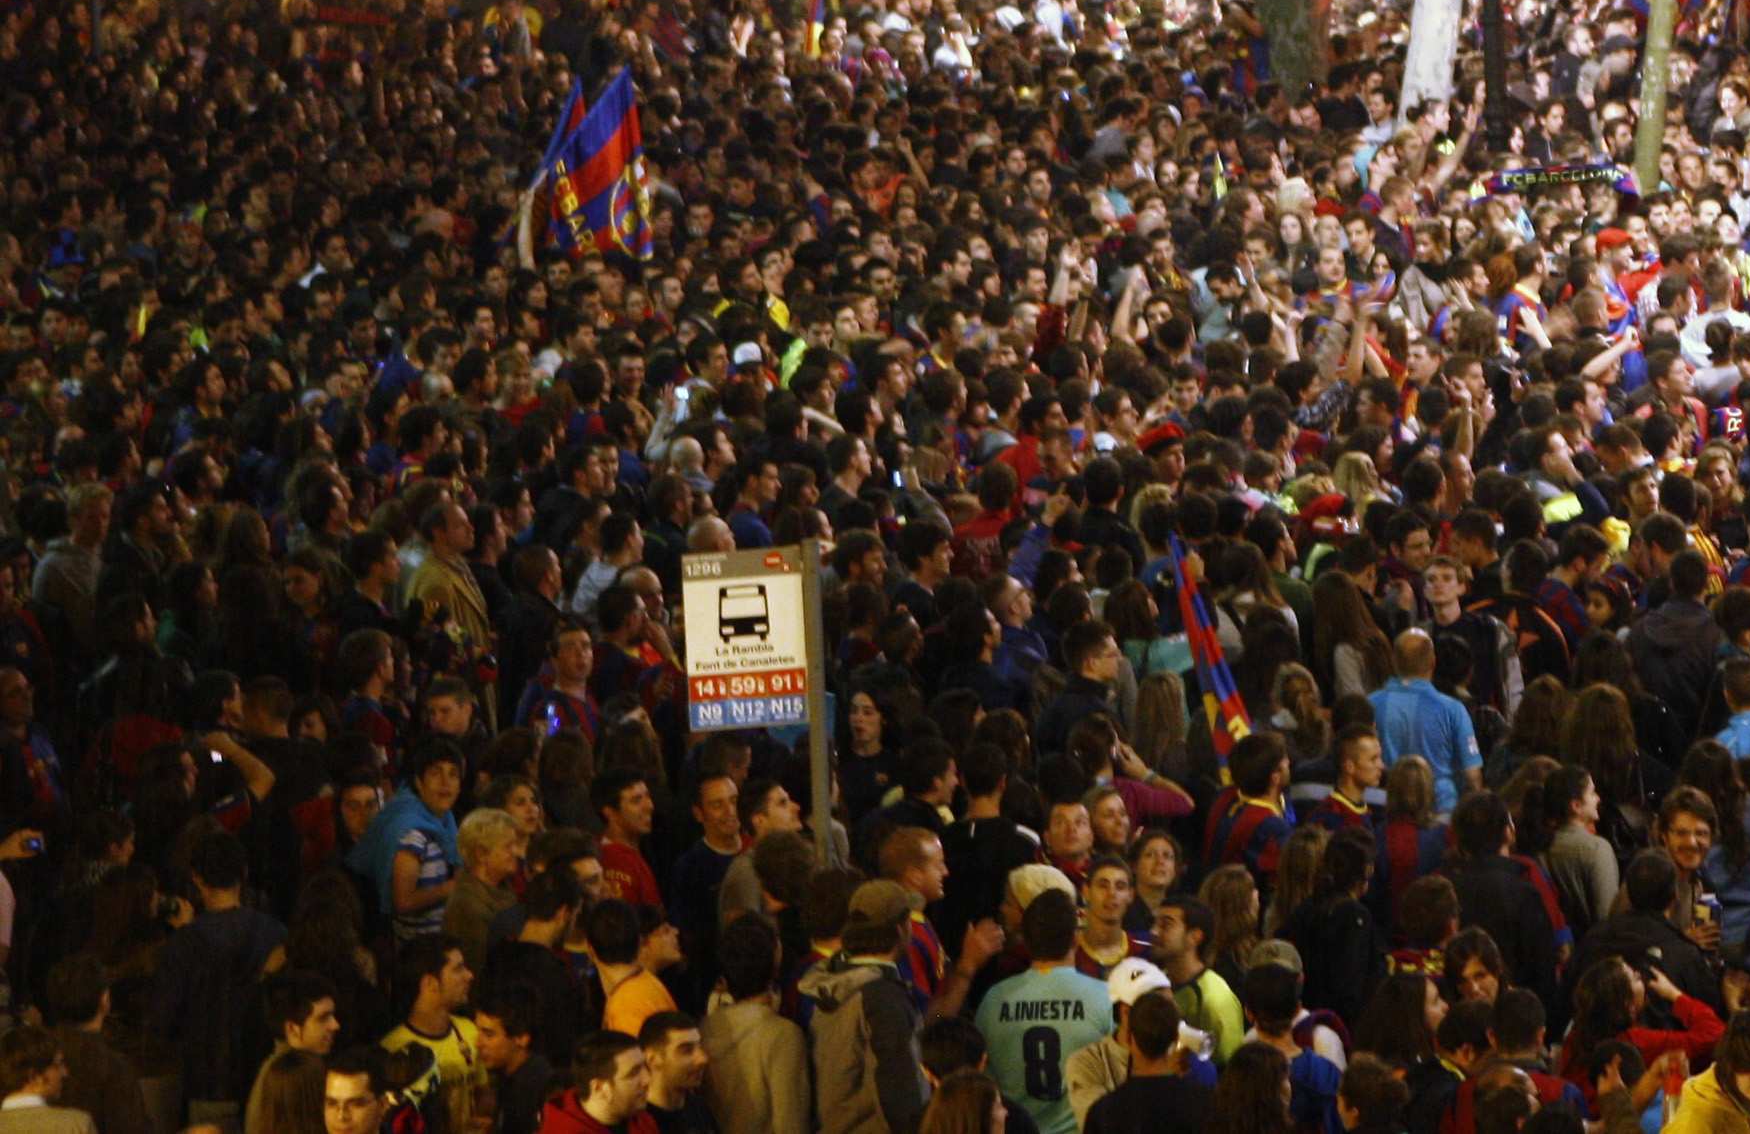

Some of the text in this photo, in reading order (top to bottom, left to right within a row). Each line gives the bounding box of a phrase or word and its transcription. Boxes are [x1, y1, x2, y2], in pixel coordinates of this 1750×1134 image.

[685, 562, 722, 577] 1296
[715, 643, 775, 657] La Rambla
[695, 655, 796, 672] Font de Canaletes
[695, 674, 793, 697] 14 59 91
[698, 704, 723, 720] N9
[732, 700, 766, 717] N12
[998, 998, 1086, 1023] A.INIESTA
[1022, 1024, 1063, 1102] 8
